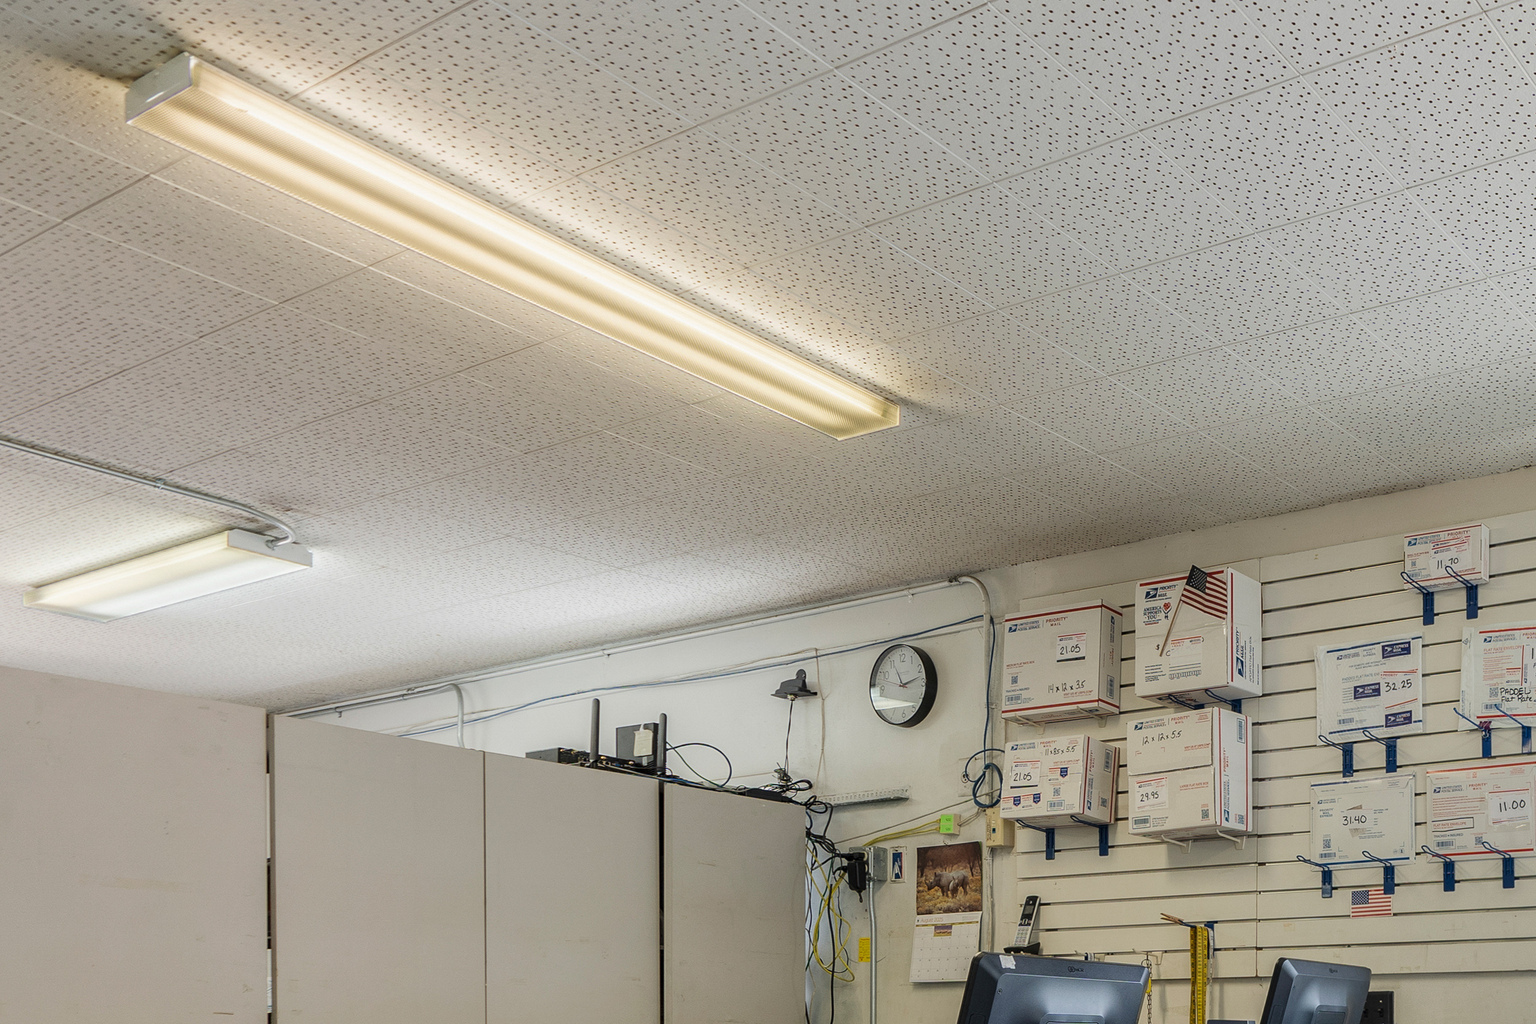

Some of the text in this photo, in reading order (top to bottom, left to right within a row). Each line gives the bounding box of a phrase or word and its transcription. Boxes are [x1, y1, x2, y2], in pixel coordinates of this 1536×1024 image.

[1436, 557, 1459, 570] 11.70
[1059, 643, 1081, 655] 21.05
[899, 653, 906, 663] 12
[917, 663, 923, 674] 2
[1061, 682, 1068, 692] 12
[1385, 679, 1413, 693] 32.25
[1142, 736, 1150, 746] 12
[1157, 732, 1166, 742] 12
[1013, 771, 1032, 781] 21.05
[1140, 790, 1160, 803] 29.95
[1499, 799, 1526, 813] 11.00
[1342, 814, 1368, 827] 31.40
